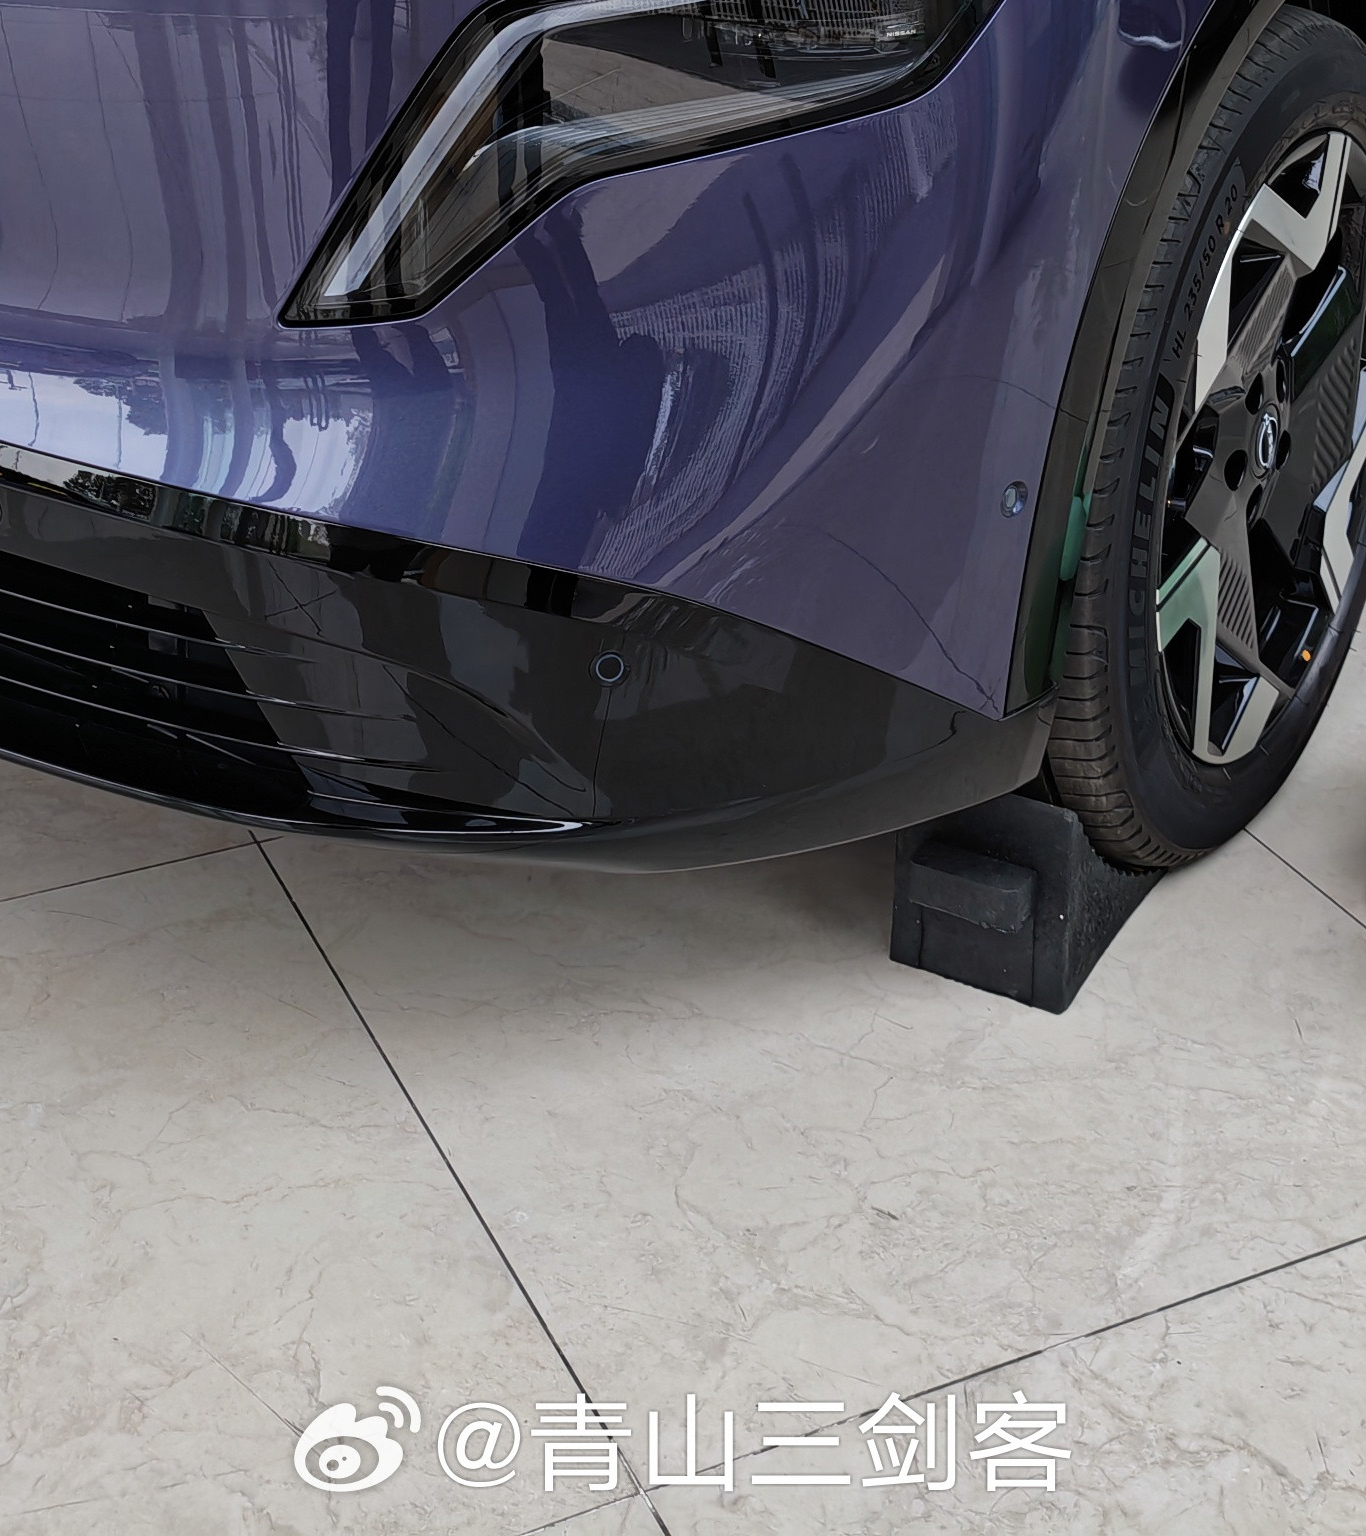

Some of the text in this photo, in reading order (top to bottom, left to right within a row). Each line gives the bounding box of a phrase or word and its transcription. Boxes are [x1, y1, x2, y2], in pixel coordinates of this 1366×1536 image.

[886, 29, 917, 37] NISSAN
[1172, 331, 1187, 359] HL
[1184, 235, 1217, 322] 235/50
[1224, 184, 1238, 216] 20
[1128, 394, 1171, 687] MICHELIN
